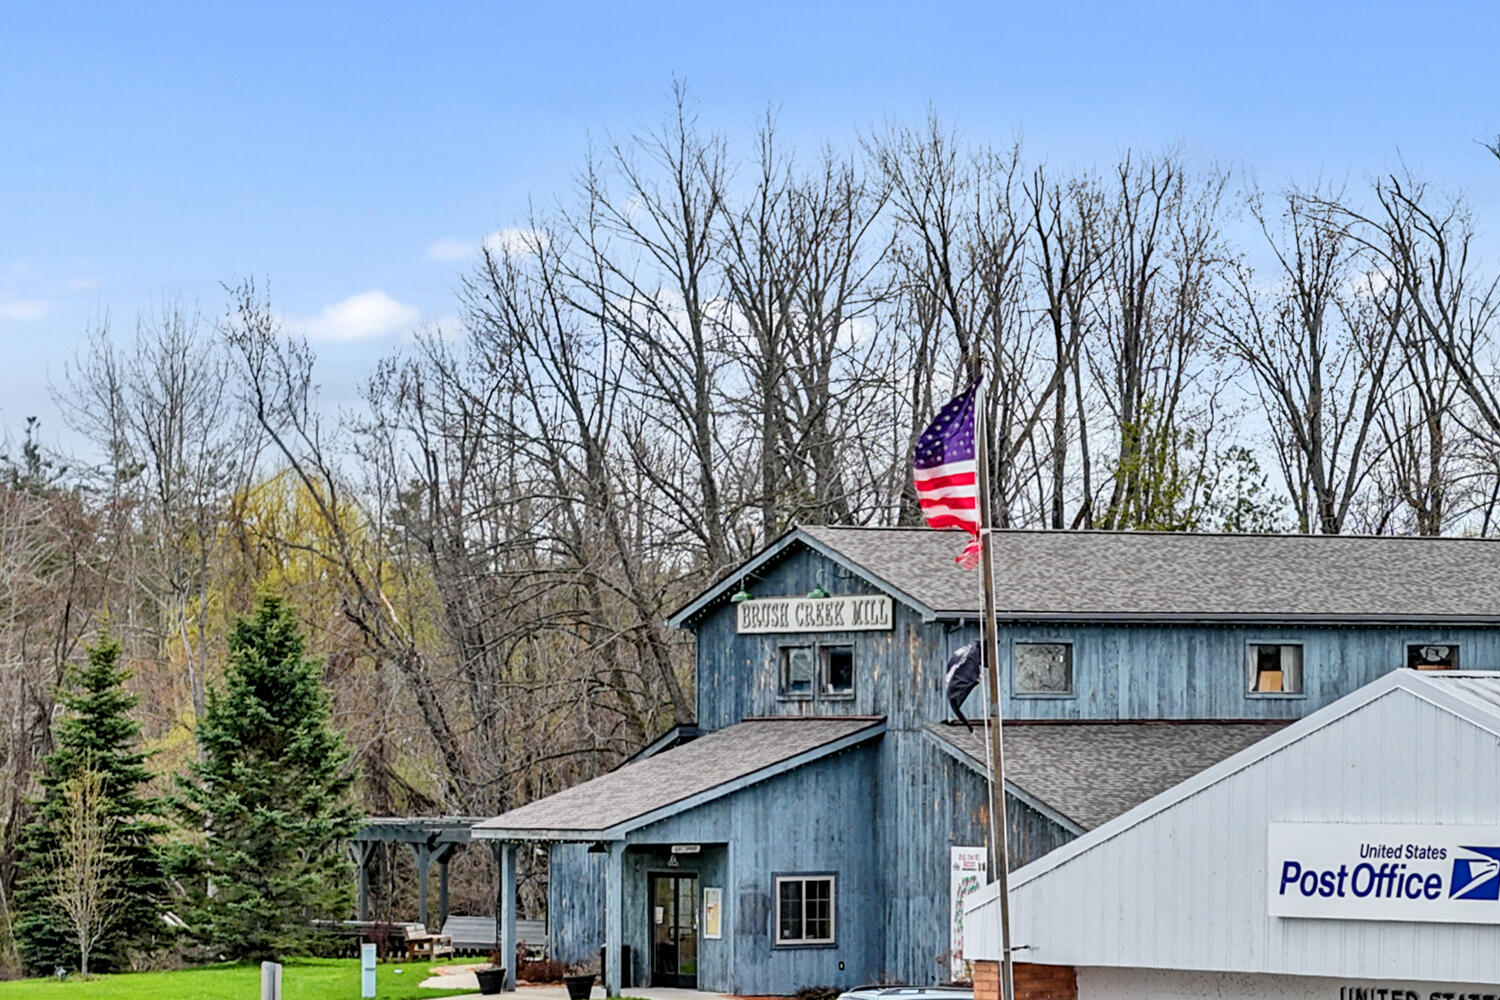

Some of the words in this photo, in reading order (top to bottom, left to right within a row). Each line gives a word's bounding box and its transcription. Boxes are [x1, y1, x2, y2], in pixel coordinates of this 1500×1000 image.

[741, 602, 789, 629] BRUSH
[795, 601, 845, 628] CREEK
[852, 600, 888, 626] MILL
[1359, 843, 1402, 859] United
[1405, 844, 1447, 860] States
